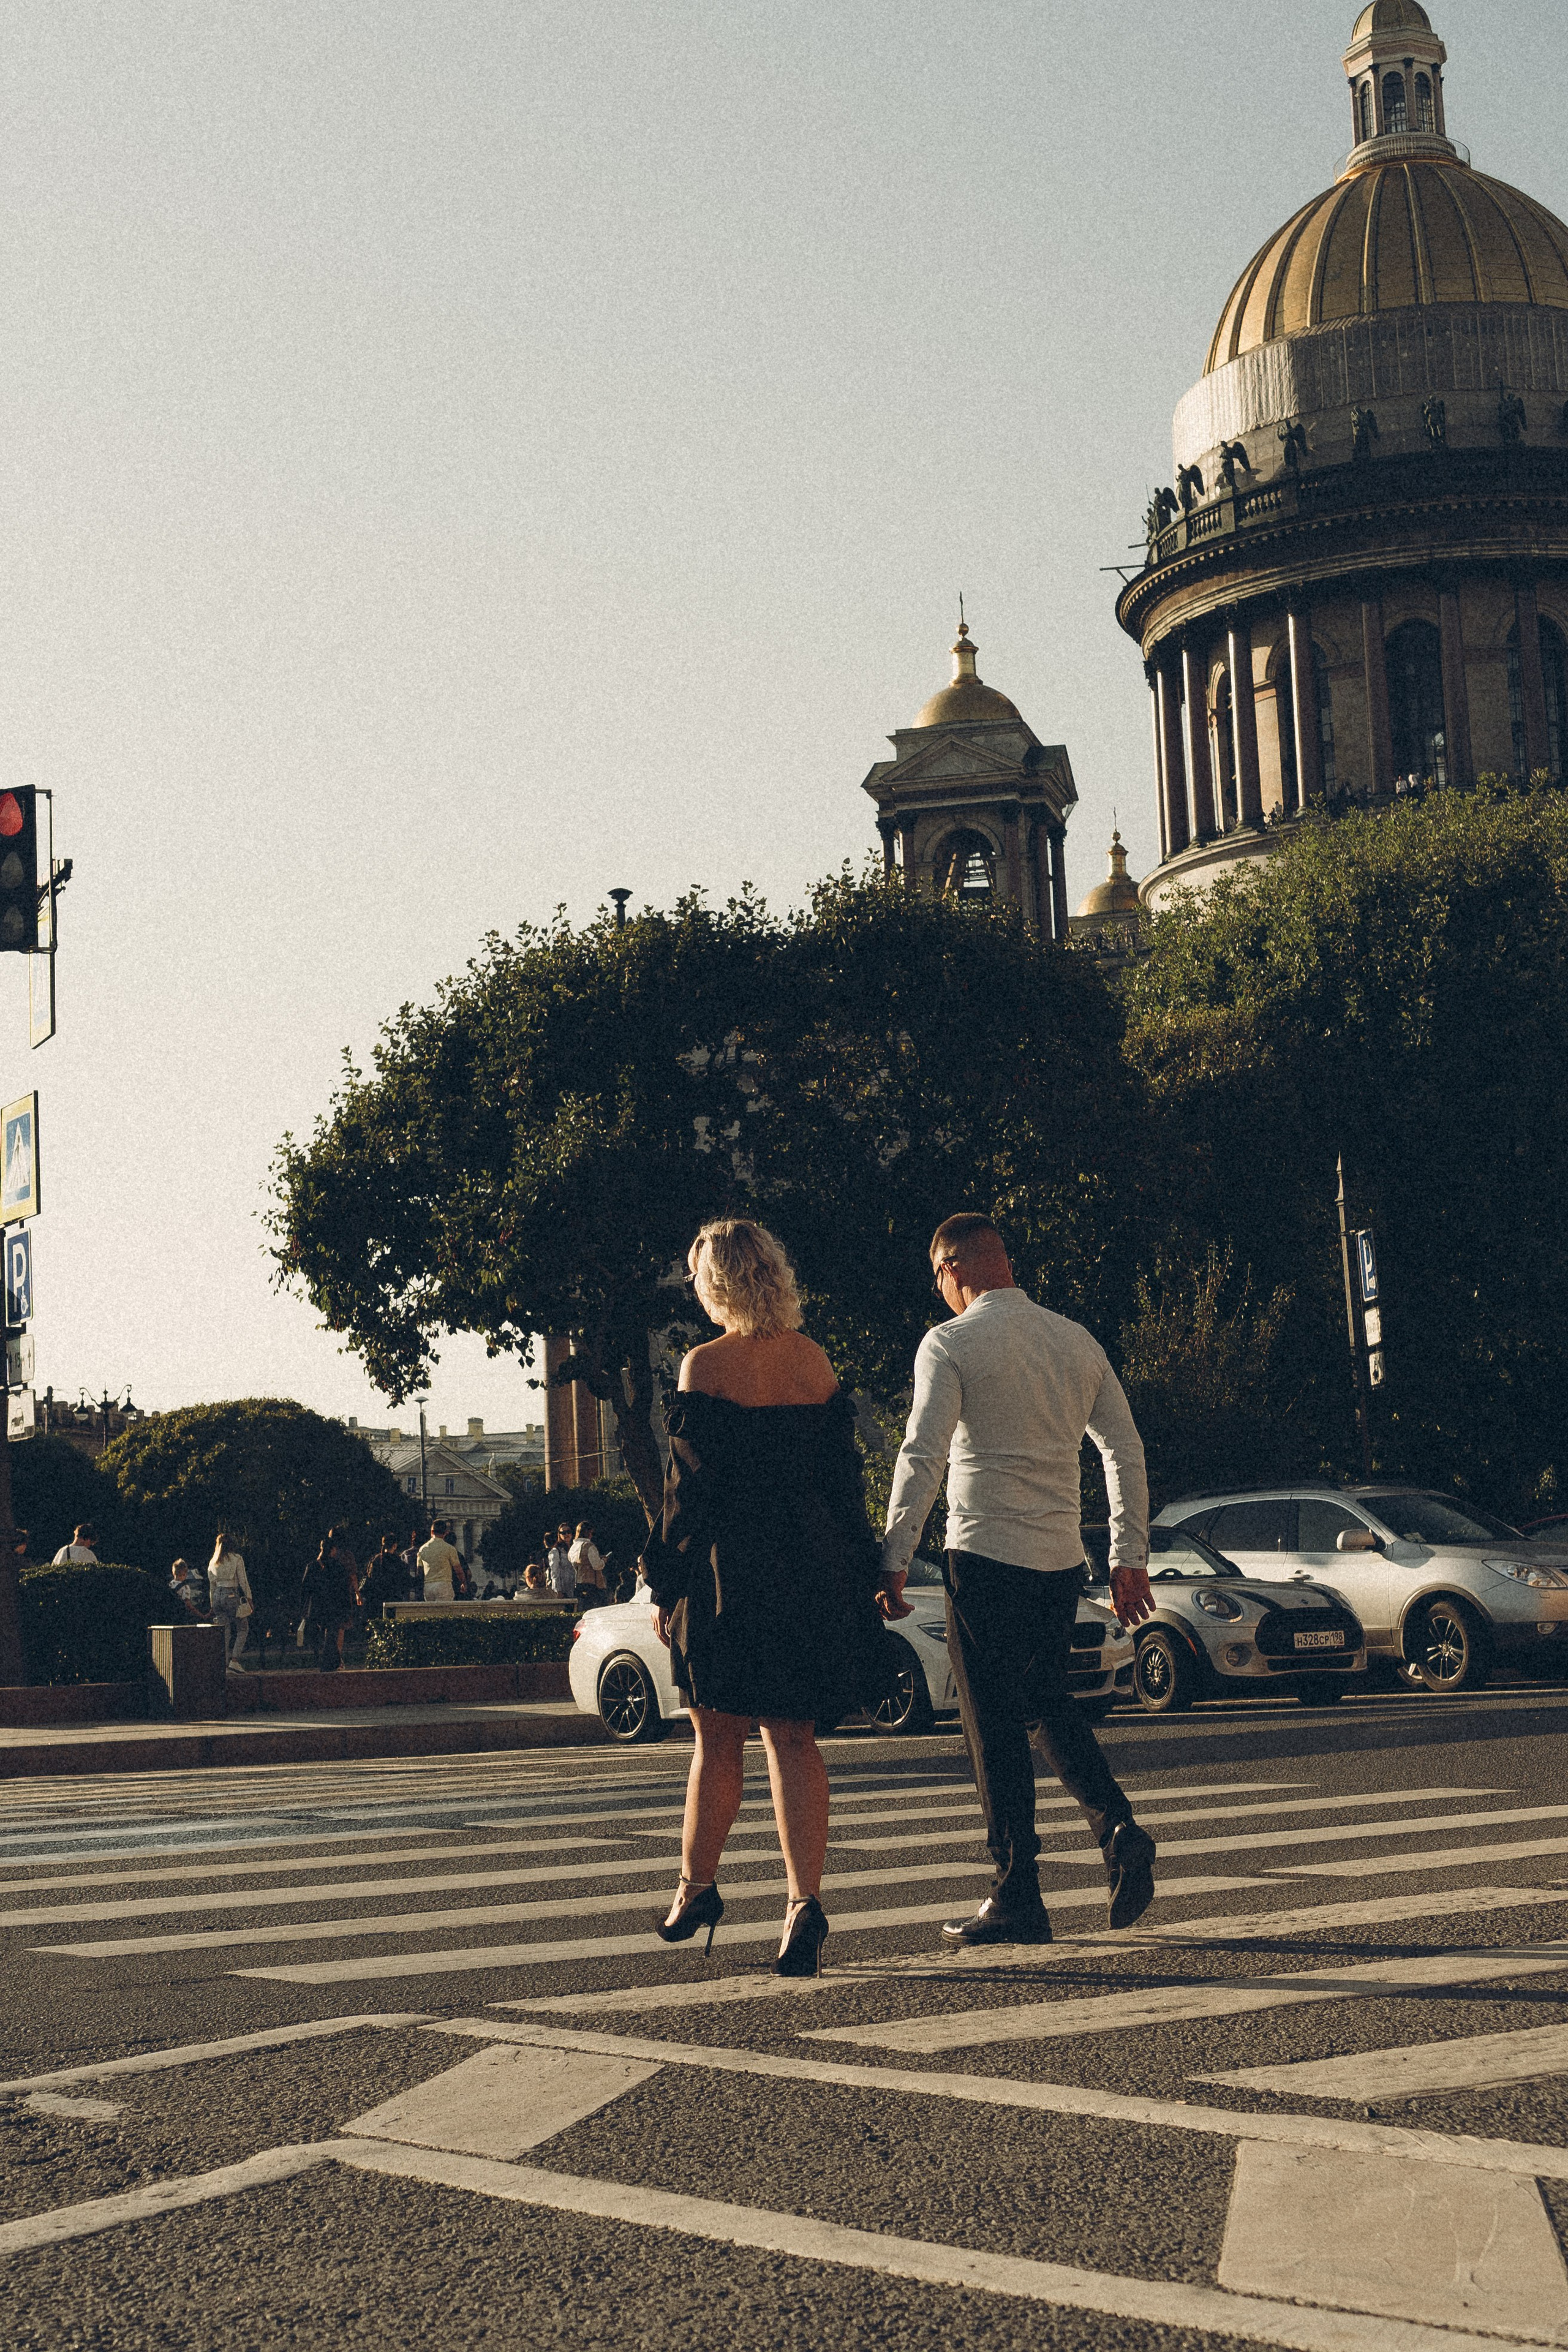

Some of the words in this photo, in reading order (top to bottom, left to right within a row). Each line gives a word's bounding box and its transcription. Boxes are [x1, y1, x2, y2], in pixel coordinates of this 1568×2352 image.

[13, 1243, 26, 1312] P
[1363, 1239, 1373, 1291] P
[1331, 1632, 1343, 1642] 198
